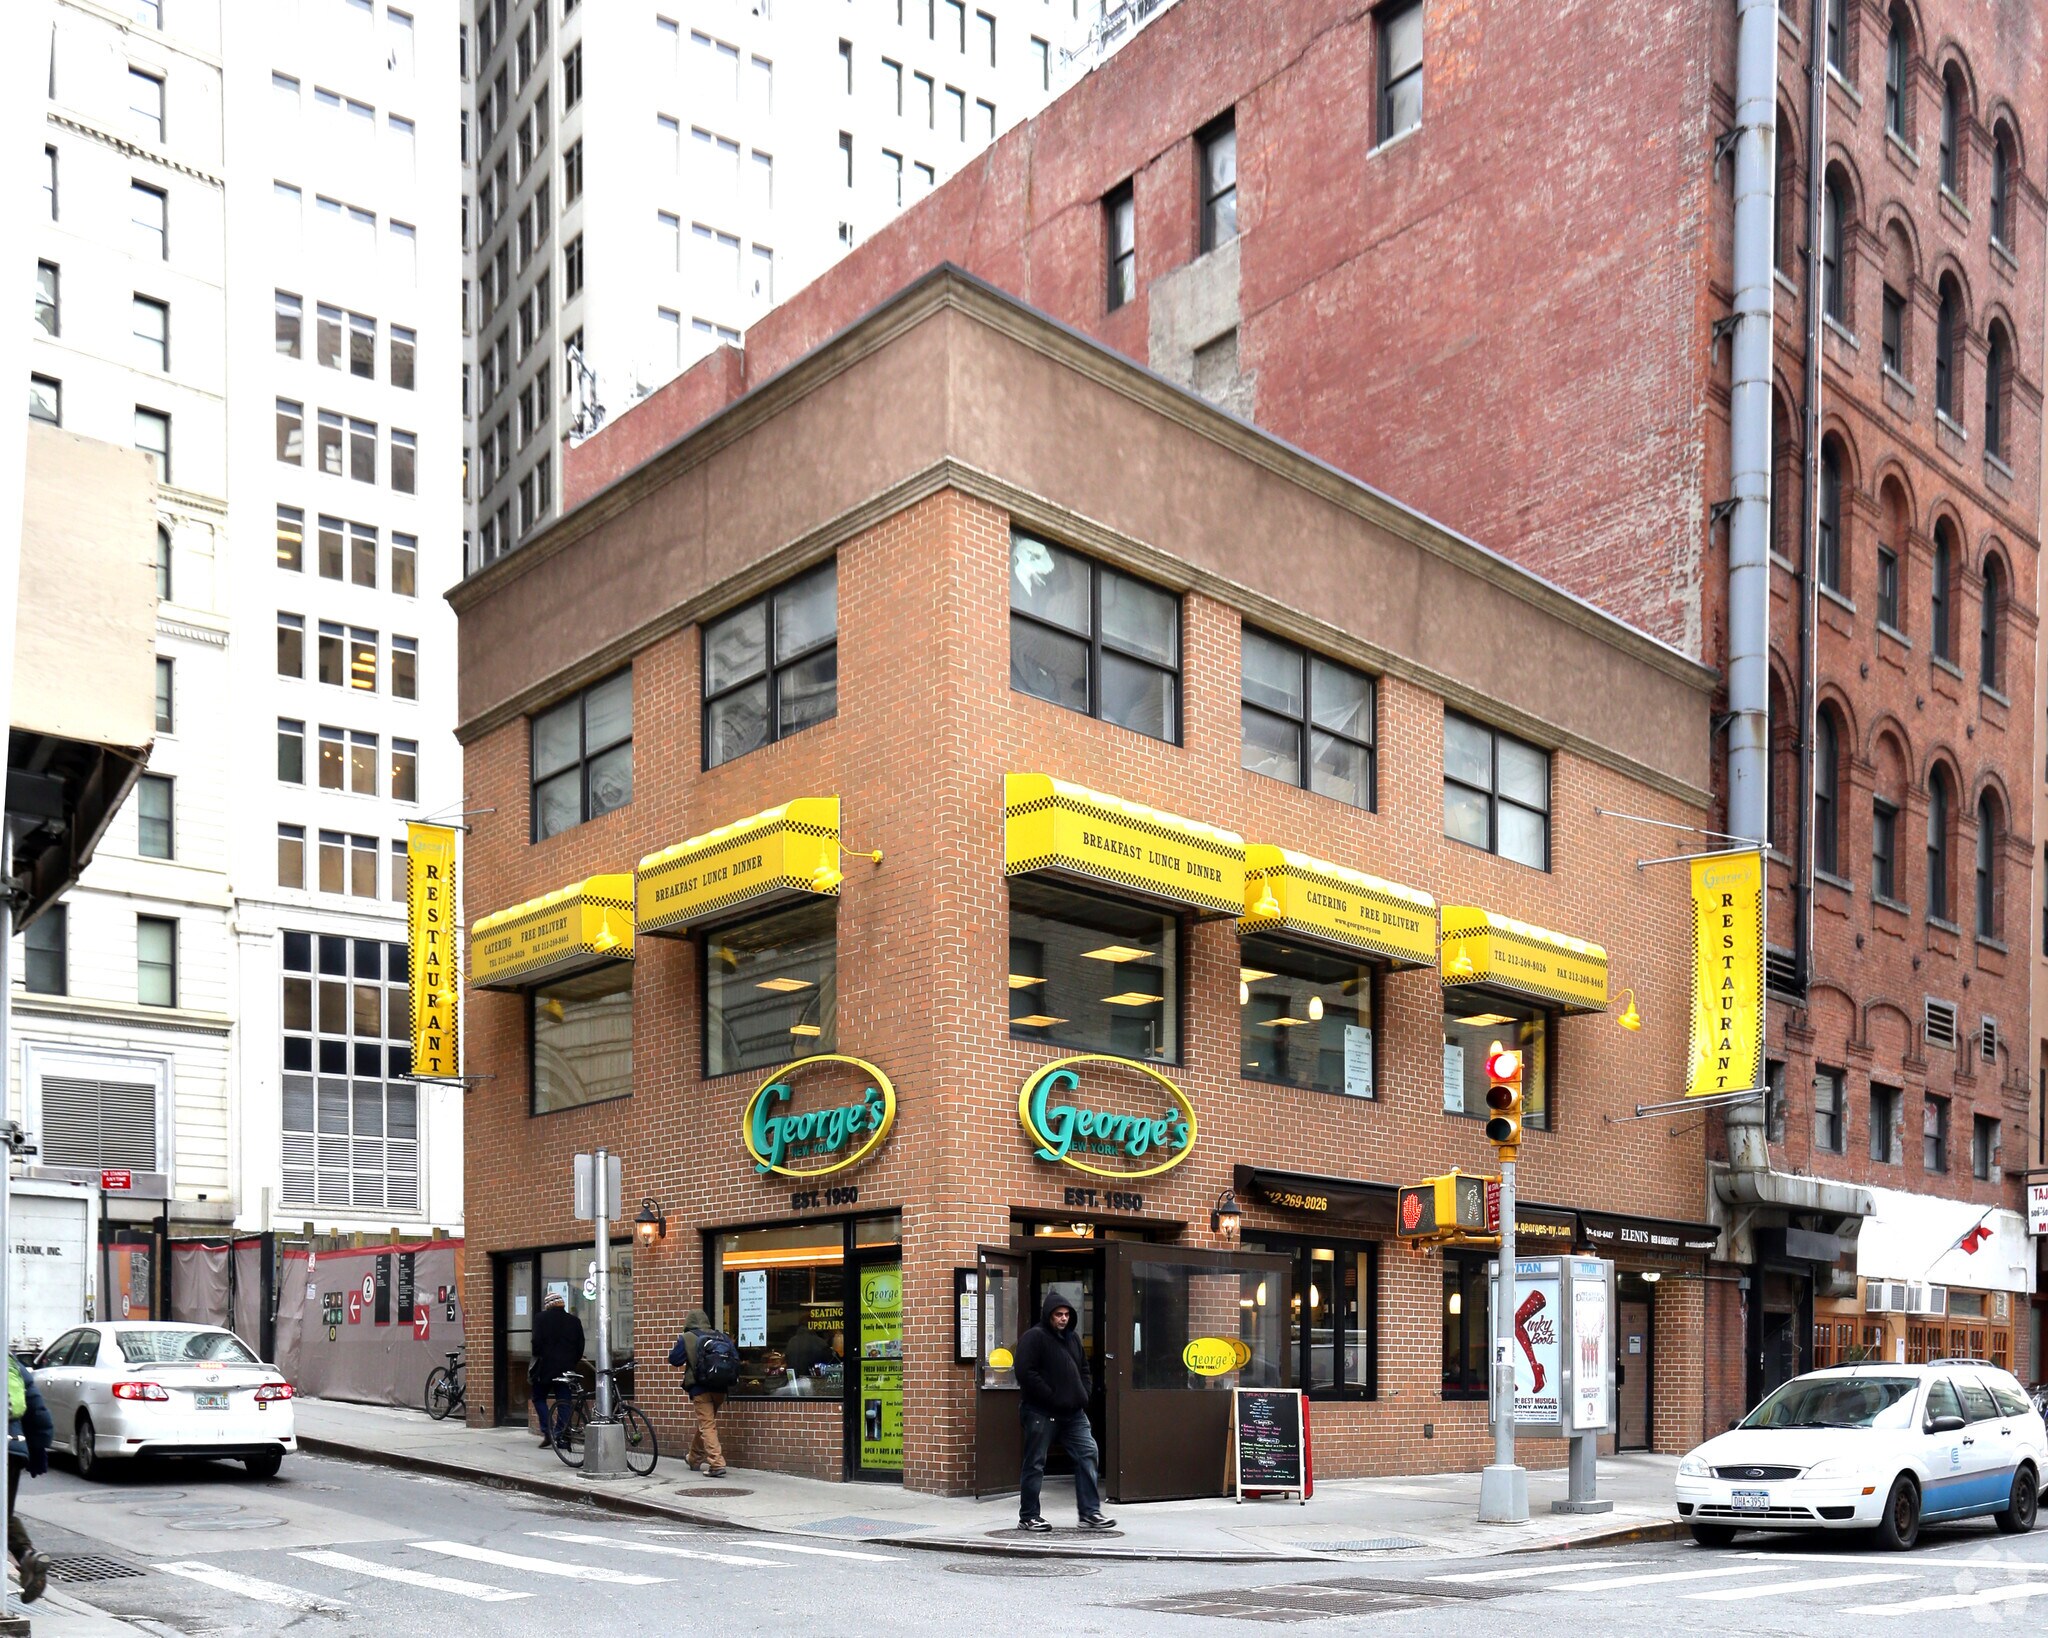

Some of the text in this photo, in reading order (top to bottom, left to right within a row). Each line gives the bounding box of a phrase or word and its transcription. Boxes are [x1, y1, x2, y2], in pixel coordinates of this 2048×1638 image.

[1083, 832, 1222, 883] BREAKFAST LUNCH DINNER
[655, 855, 763, 902] BREAKFAST LUNCH DINNER
[1306, 890, 1420, 933] CATERING FREE DELIVERY
[484, 917, 568, 956] CATERING FREE DELIVERY
[426, 864, 441, 1072] RESTAURANT
[1494, 950, 1506, 962] TEL
[1507, 955, 1547, 974] 212-269-8026
[1556, 967, 1568, 979] FAX
[1716, 893, 1735, 1088] RESTAURANT
[1031, 1069, 1190, 1161] George's
[752, 1084, 886, 1174] George's
[1090, 1142, 1119, 1156] YORK
[792, 1186, 859, 1209] EST. 1950
[1064, 1187, 1143, 1211] EST. 1950
[1621, 1228, 1649, 1243] ELENI'S
[16, 1245, 45, 1256] FRANK,
[46, 1246, 63, 1256] INC.
[1515, 1263, 1542, 1273] ITAN
[1580, 1263, 1597, 1274] TITAN
[808, 1320, 844, 1330] UPSTAIRS
[810, 1307, 844, 1318] SEATING
[1531, 1332, 1557, 1345] Boots
[1186, 1343, 1236, 1373] George's
